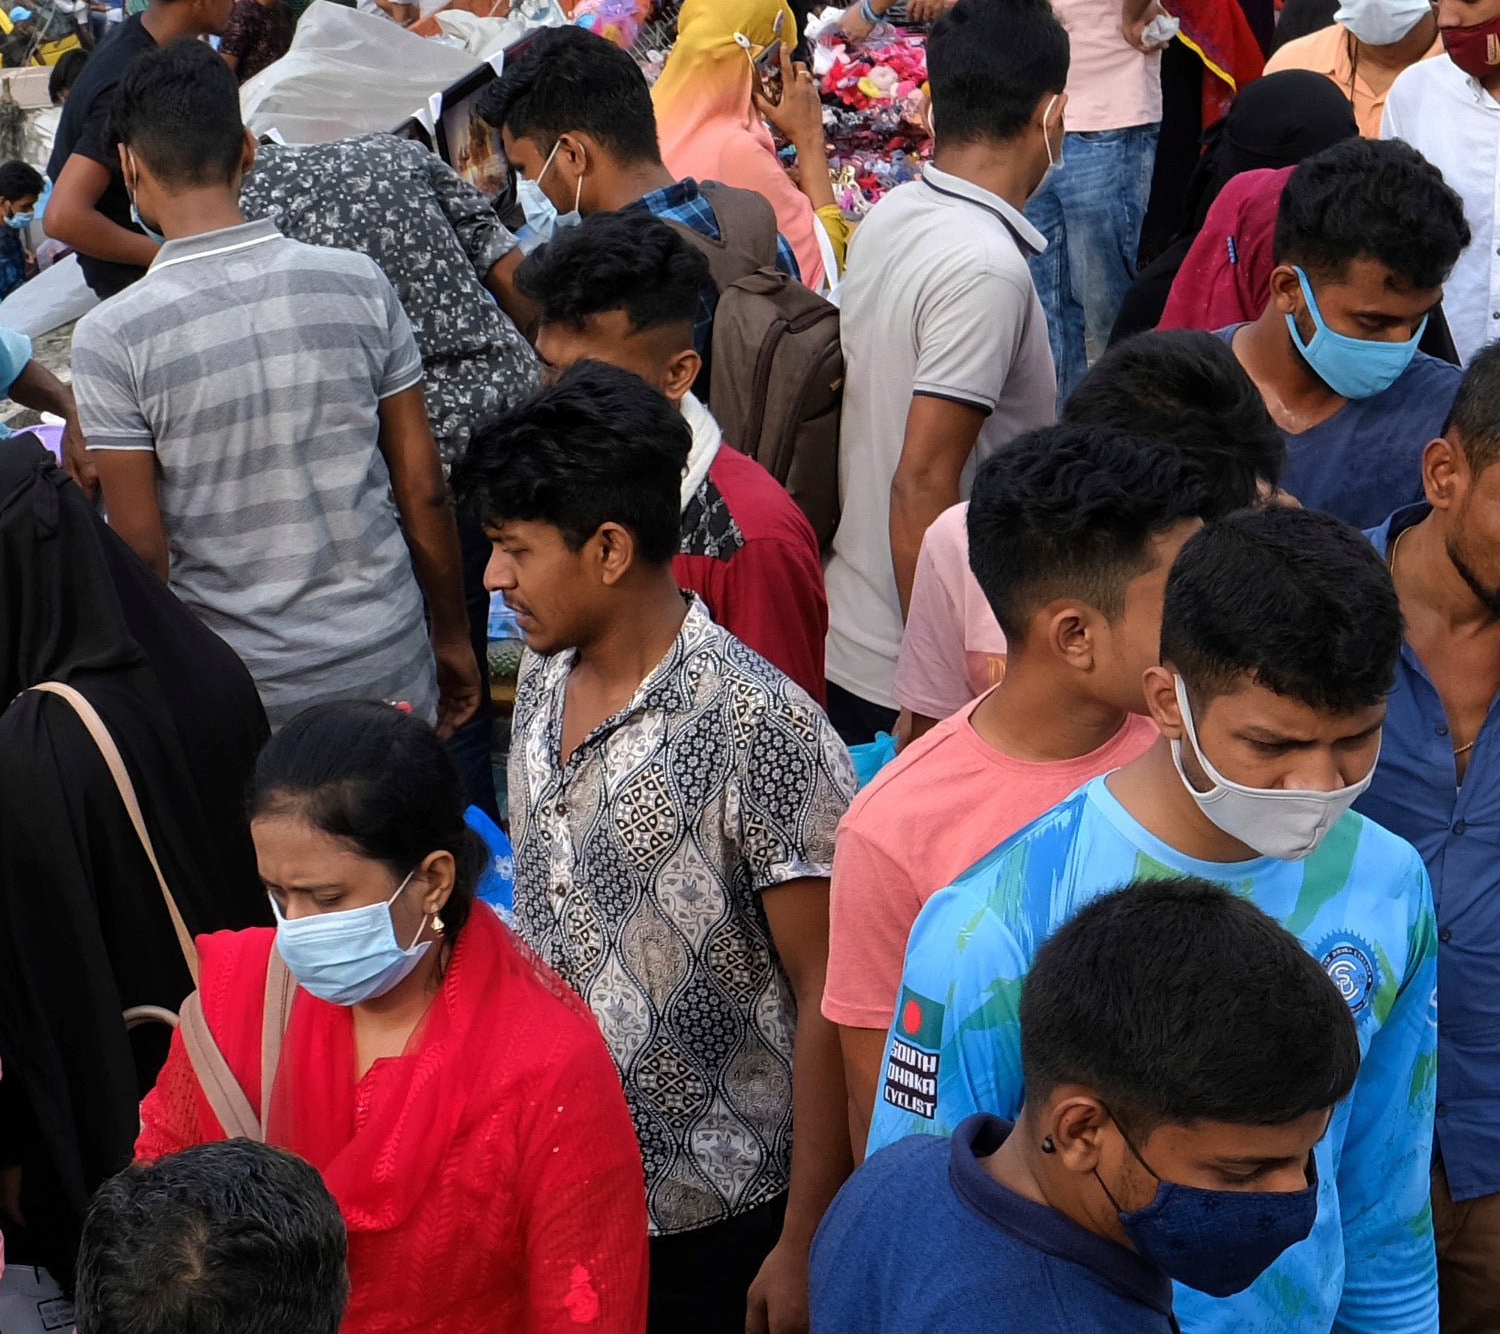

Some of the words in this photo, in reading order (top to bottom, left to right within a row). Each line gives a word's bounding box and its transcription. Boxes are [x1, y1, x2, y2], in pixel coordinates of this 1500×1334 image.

[891, 1040, 937, 1073] SOUTH
[886, 1063, 936, 1096] DHAKA
[884, 1087, 935, 1118] CYCLIST
